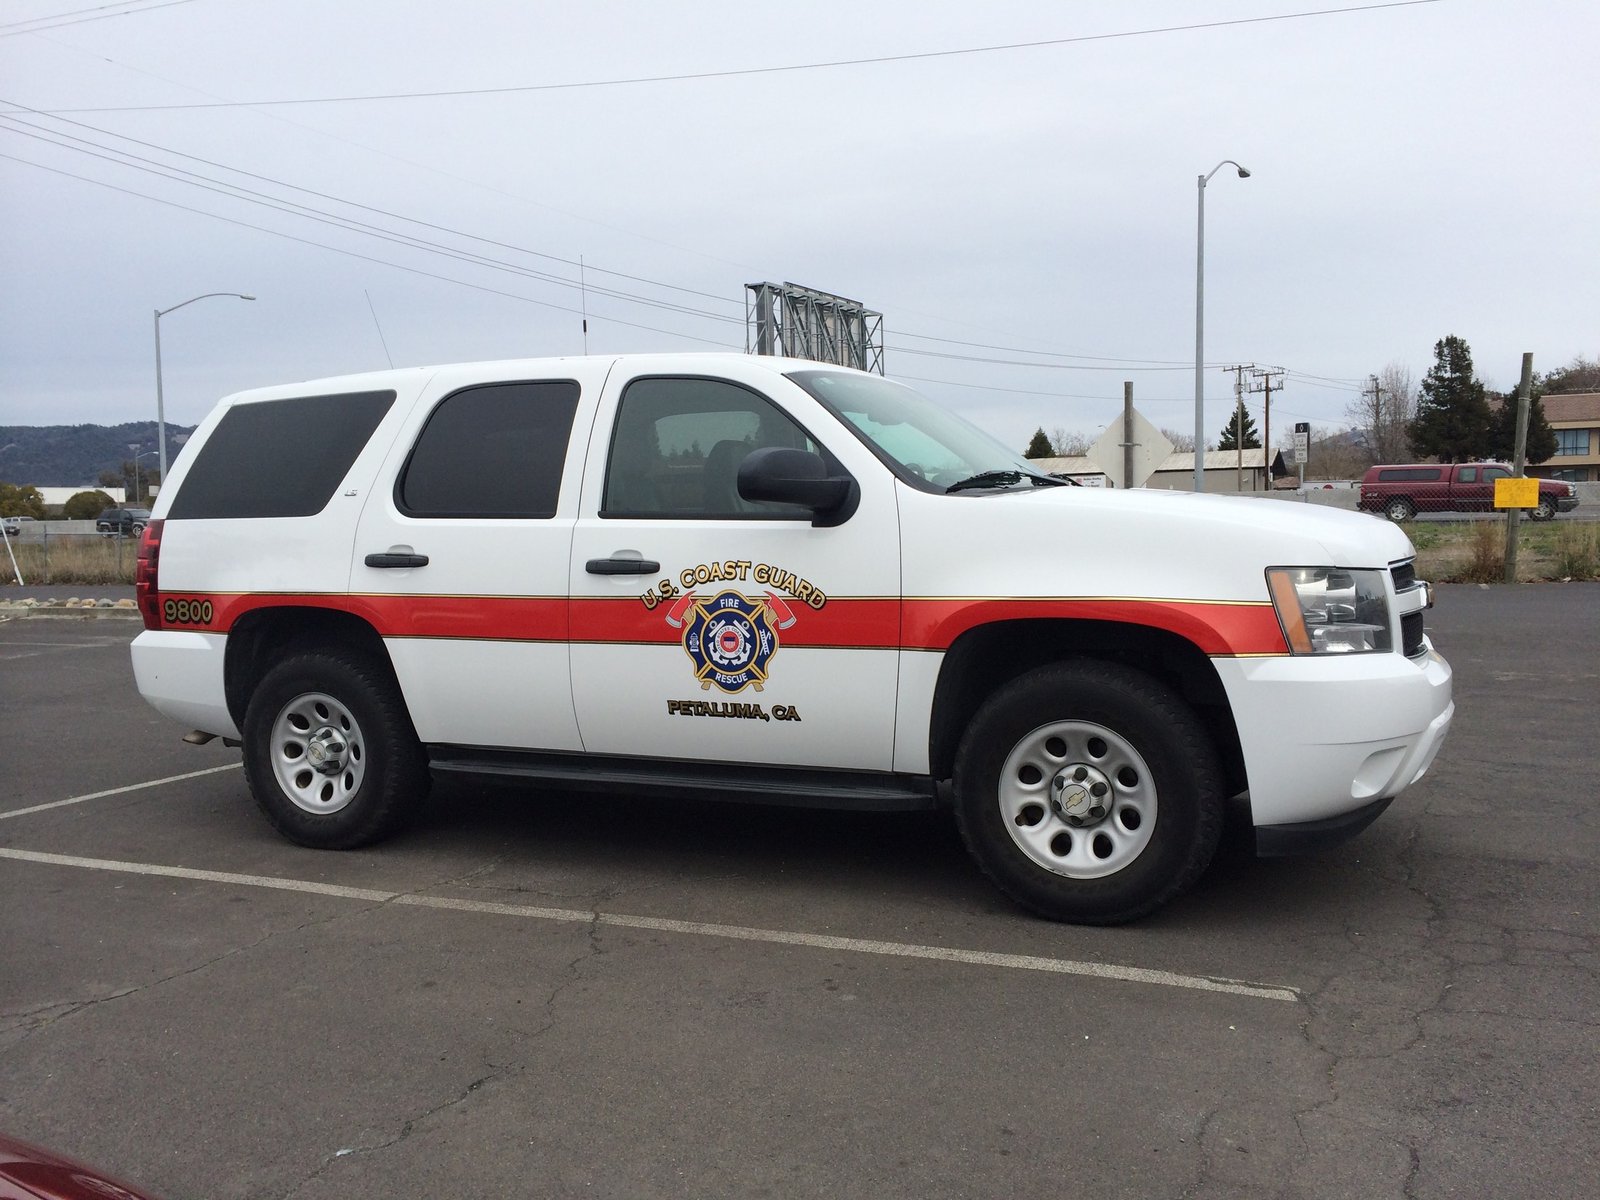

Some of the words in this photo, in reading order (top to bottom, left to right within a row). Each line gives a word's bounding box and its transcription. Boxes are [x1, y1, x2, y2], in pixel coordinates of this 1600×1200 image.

[640, 579, 679, 610] U.S.
[680, 560, 751, 589] COAST
[753, 563, 827, 610] GUARD
[163, 598, 214, 625] 9800
[720, 598, 740, 609] FIRE
[715, 672, 748, 684] RESCUE
[667, 700, 770, 722] PETALUMA,
[771, 705, 802, 722] CA
